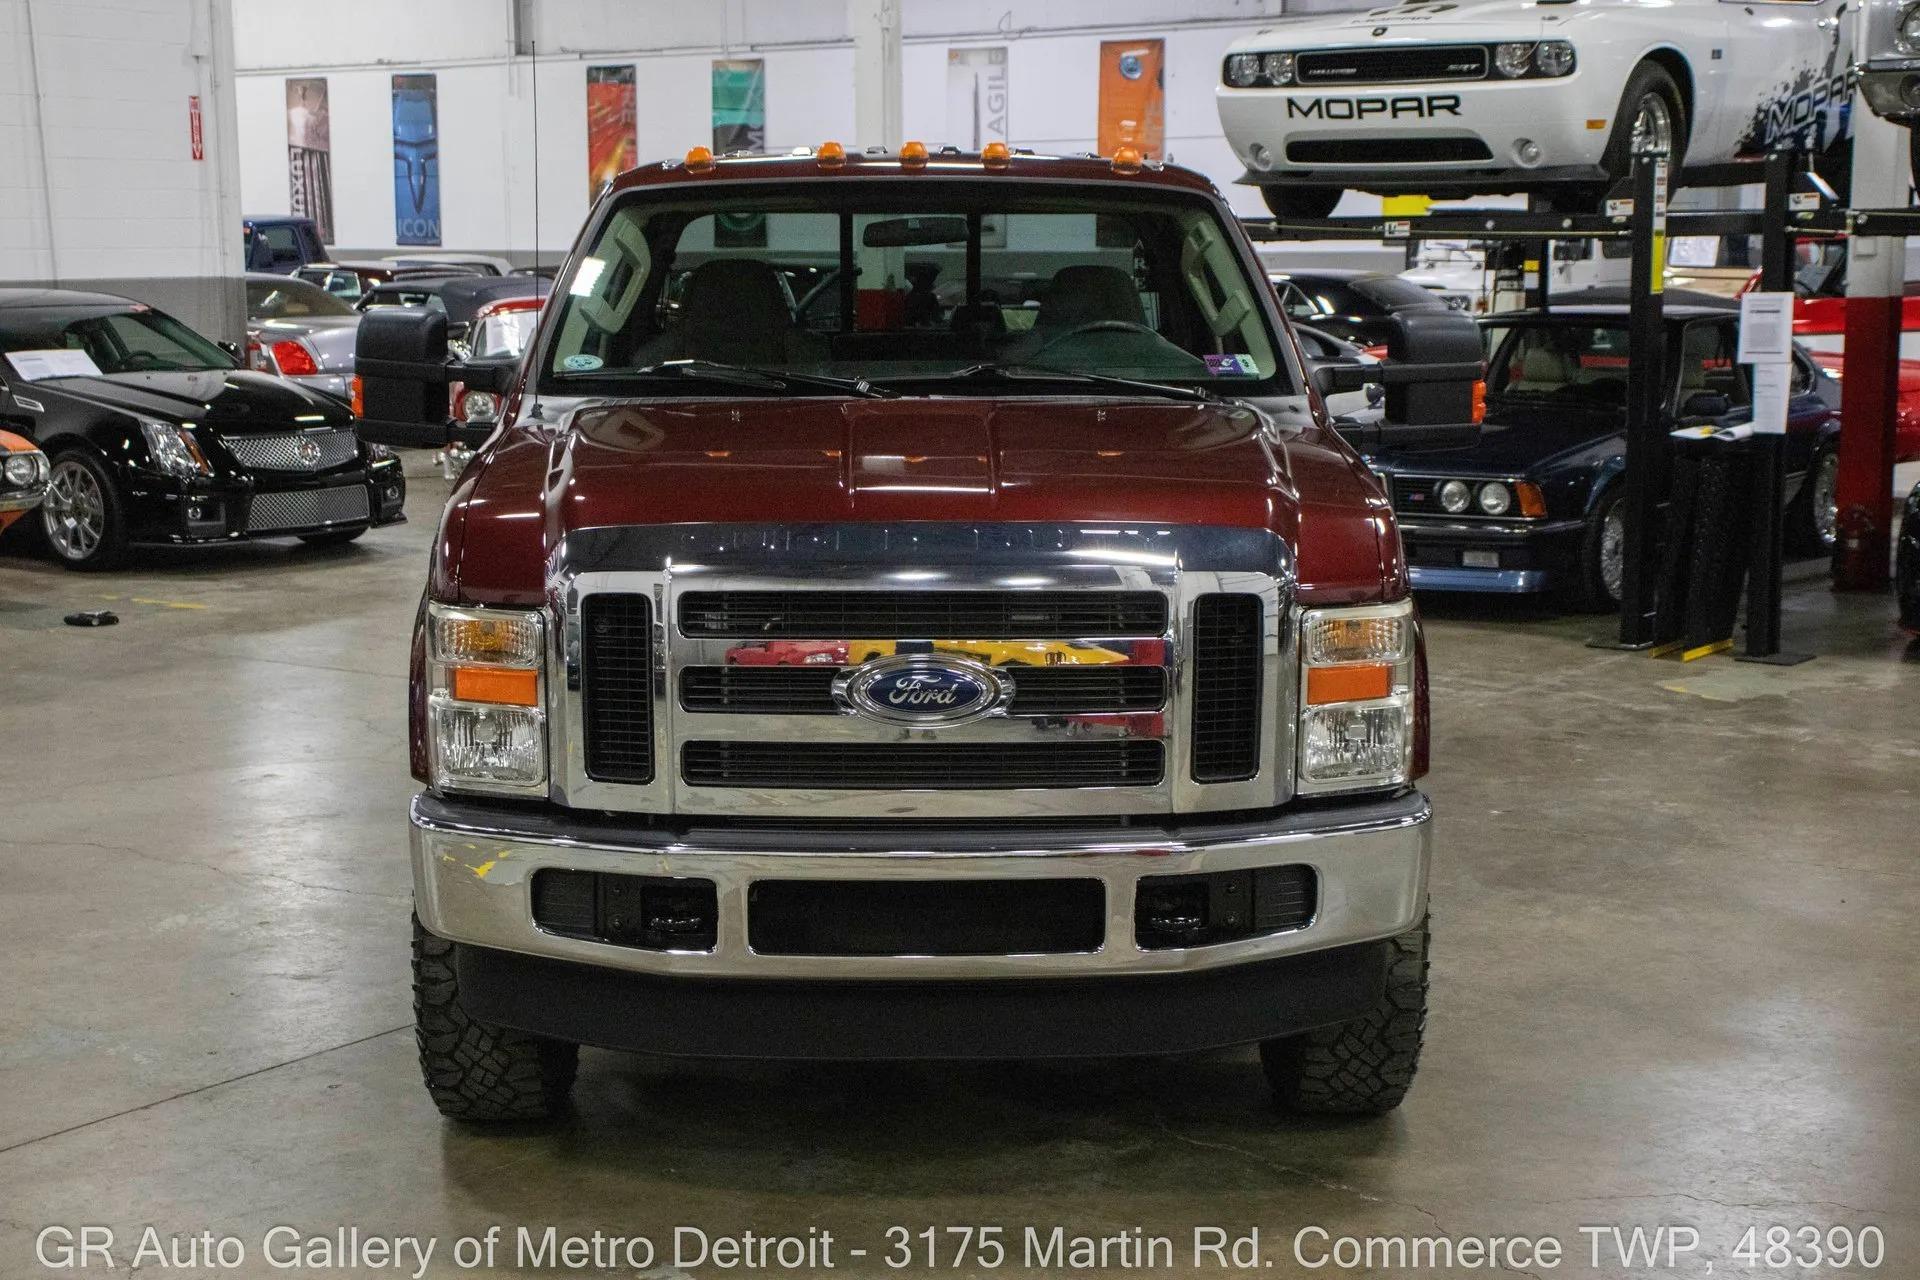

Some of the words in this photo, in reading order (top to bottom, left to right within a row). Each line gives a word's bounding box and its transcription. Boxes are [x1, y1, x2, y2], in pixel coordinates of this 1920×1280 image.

[1287, 94, 1463, 120] MOPAR
[289, 147, 305, 217] LUXU
[397, 218, 441, 238] ICON
[888, 676, 957, 704] Ford
